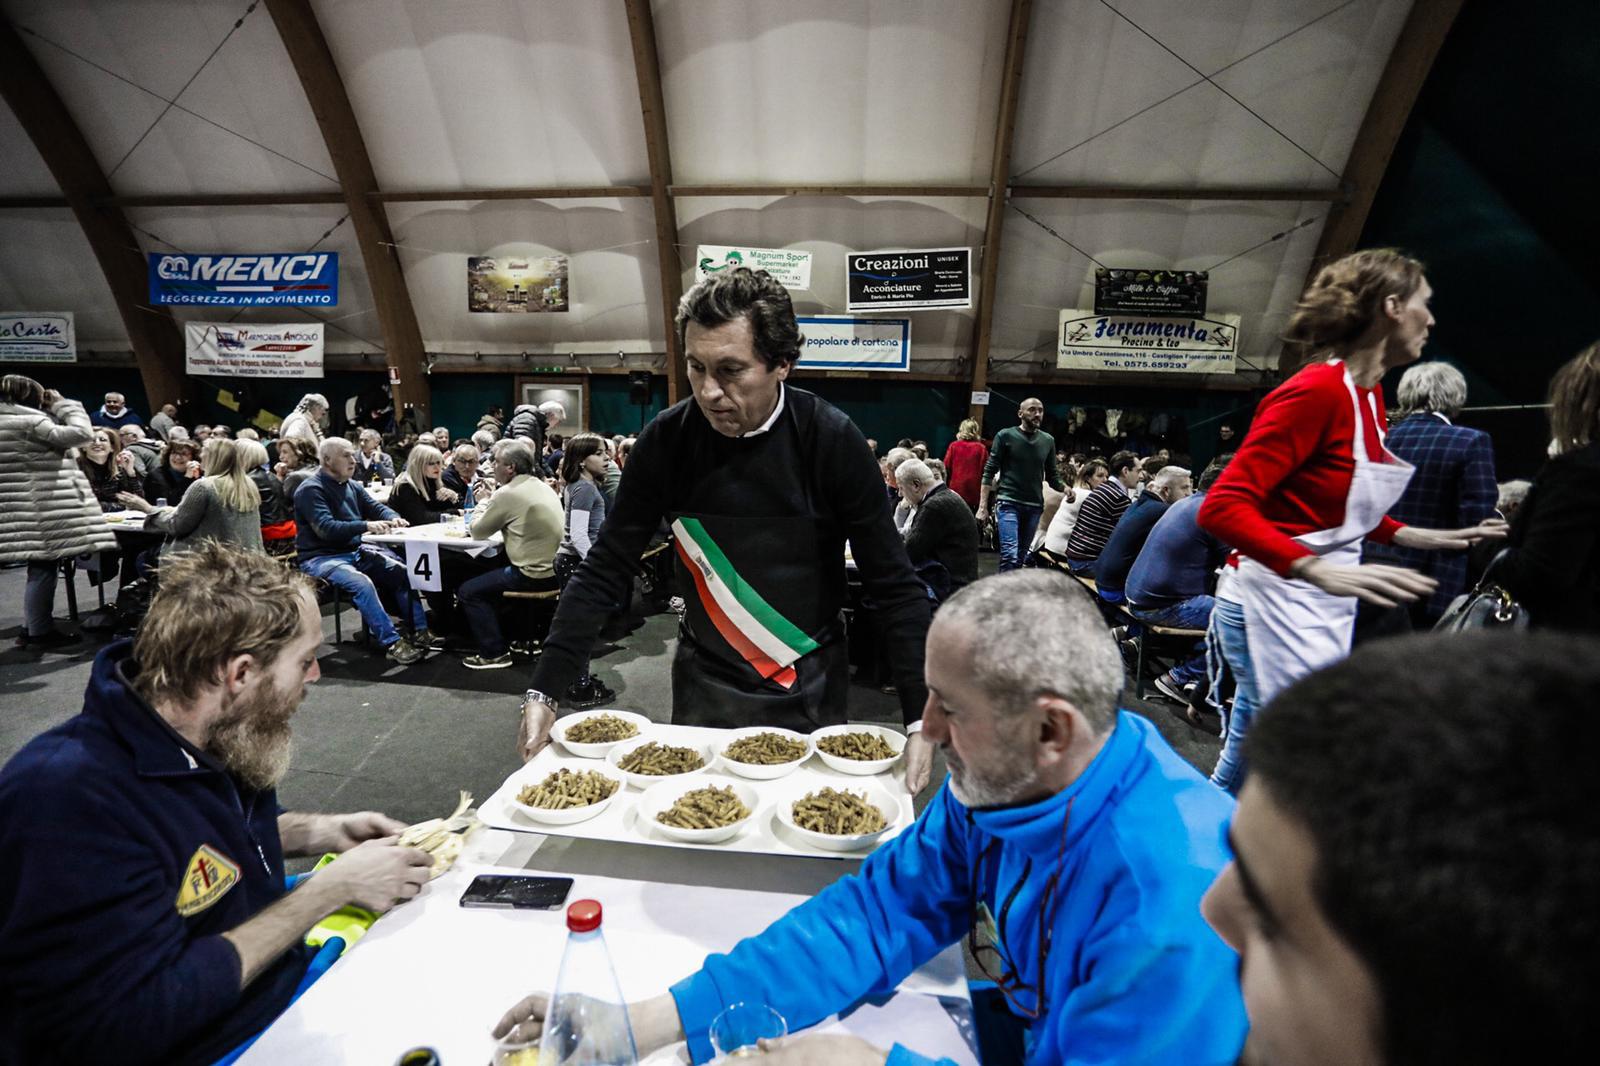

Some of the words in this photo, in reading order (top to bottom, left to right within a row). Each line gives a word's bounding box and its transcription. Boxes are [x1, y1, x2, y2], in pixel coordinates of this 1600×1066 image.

[750, 251, 784, 260] Magnum
[786, 253, 808, 262] Sport
[191, 254, 328, 281] MENCI
[854, 255, 929, 271] Creazioni
[862, 284, 922, 293] Acconciature
[161, 294, 235, 304] LEGGEREZZA
[239, 296, 252, 304] IN
[255, 295, 331, 304] MOVIMENTO
[13, 321, 61, 337] Carta
[1094, 317, 1207, 342] Ferramenta
[806, 336, 850, 348] popolare
[851, 336, 860, 346] di
[862, 338, 899, 346] cortona
[1121, 336, 1154, 347] Procino
[1124, 361, 1188, 369] 0575.659293
[414, 553, 432, 581] 4
